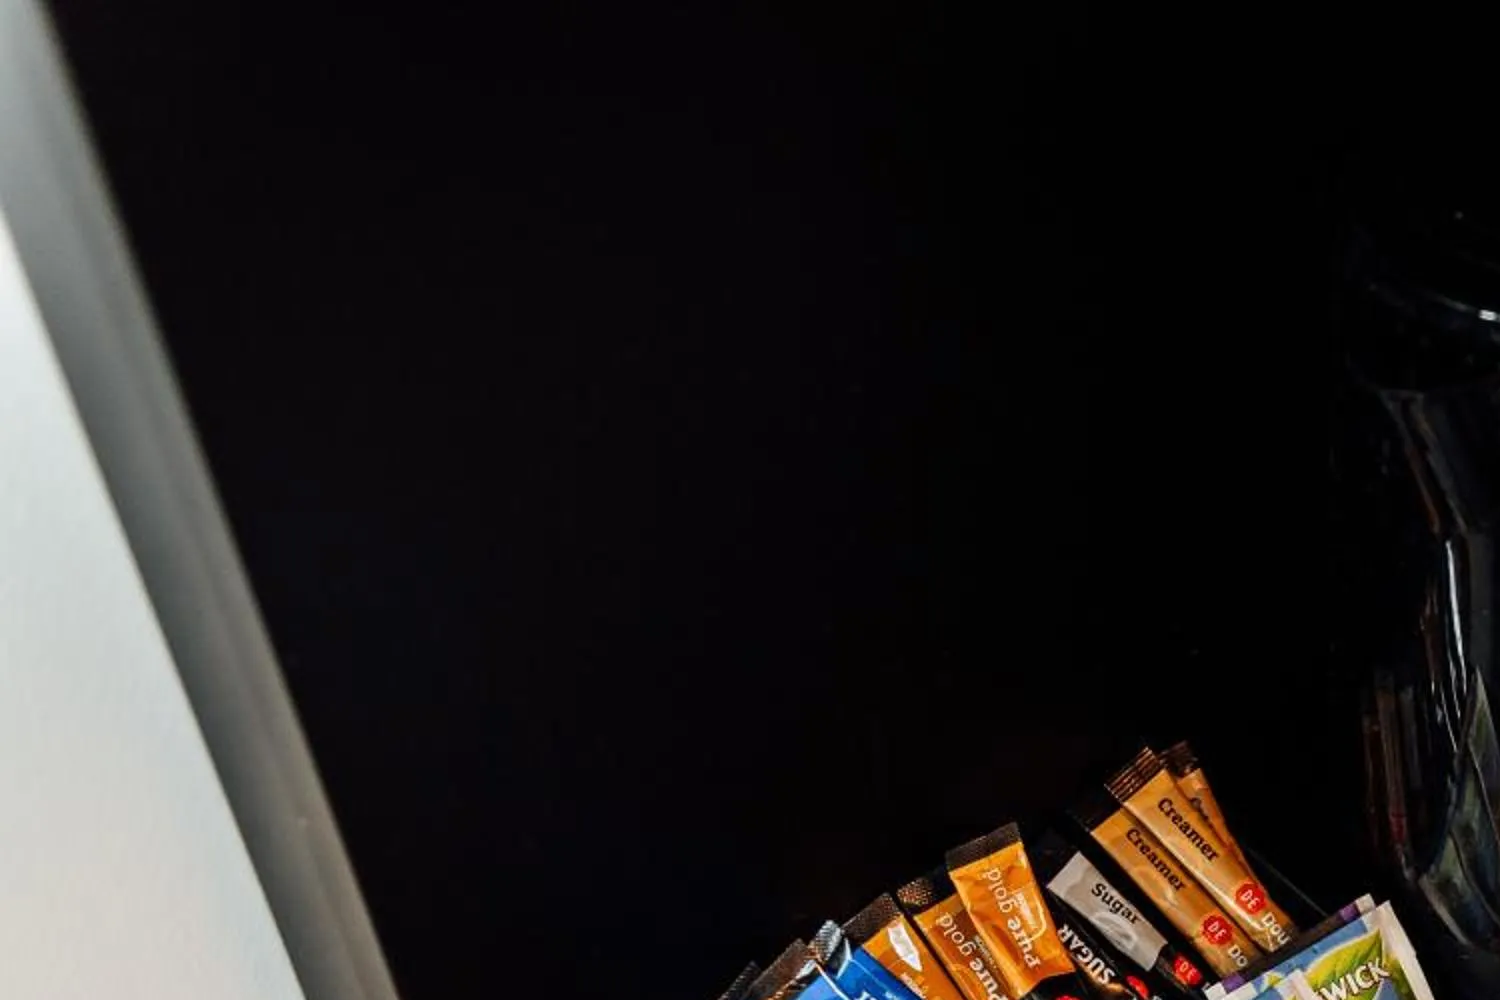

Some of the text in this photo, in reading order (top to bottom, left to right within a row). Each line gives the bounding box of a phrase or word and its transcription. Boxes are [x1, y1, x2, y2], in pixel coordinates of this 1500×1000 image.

[1158, 798, 1219, 862] Creamer
[1126, 828, 1186, 892] Creamer
[984, 867, 1019, 913] gold
[1091, 883, 1140, 926] Sugar
[935, 912, 976, 956] gold
[1007, 917, 1041, 968] Pure
[1206, 920, 1226, 940] DE
[1261, 914, 1290, 946] Dou
[1057, 923, 1115, 984] SUGAR
